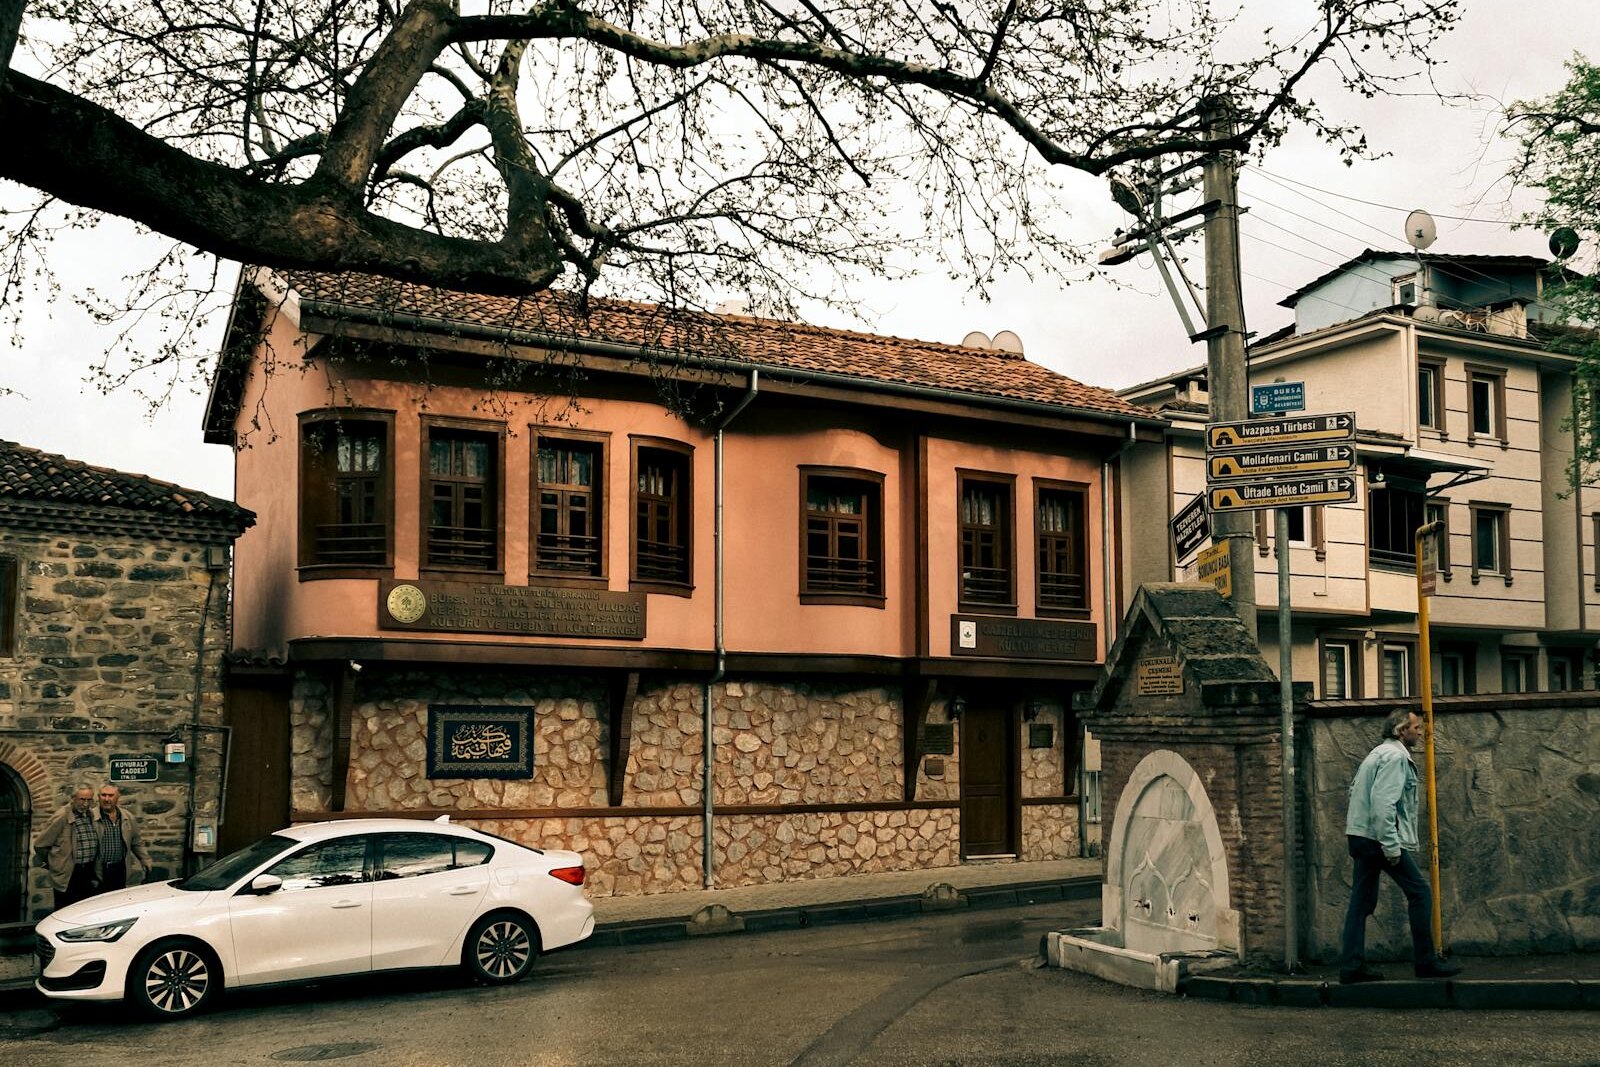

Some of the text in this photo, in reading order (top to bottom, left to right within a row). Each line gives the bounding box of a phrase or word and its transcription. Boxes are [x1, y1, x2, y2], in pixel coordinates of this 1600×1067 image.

[1274, 387, 1301, 395] BURSA
[1242, 420, 1316, 437] İvazpaşa Türbesi
[1242, 450, 1319, 466] Mollafenari Camii
[1244, 481, 1324, 499] Üftade Tekke Camii
[1176, 505, 1201, 532] TEZVEREN
[431, 592, 468, 606] BURSA
